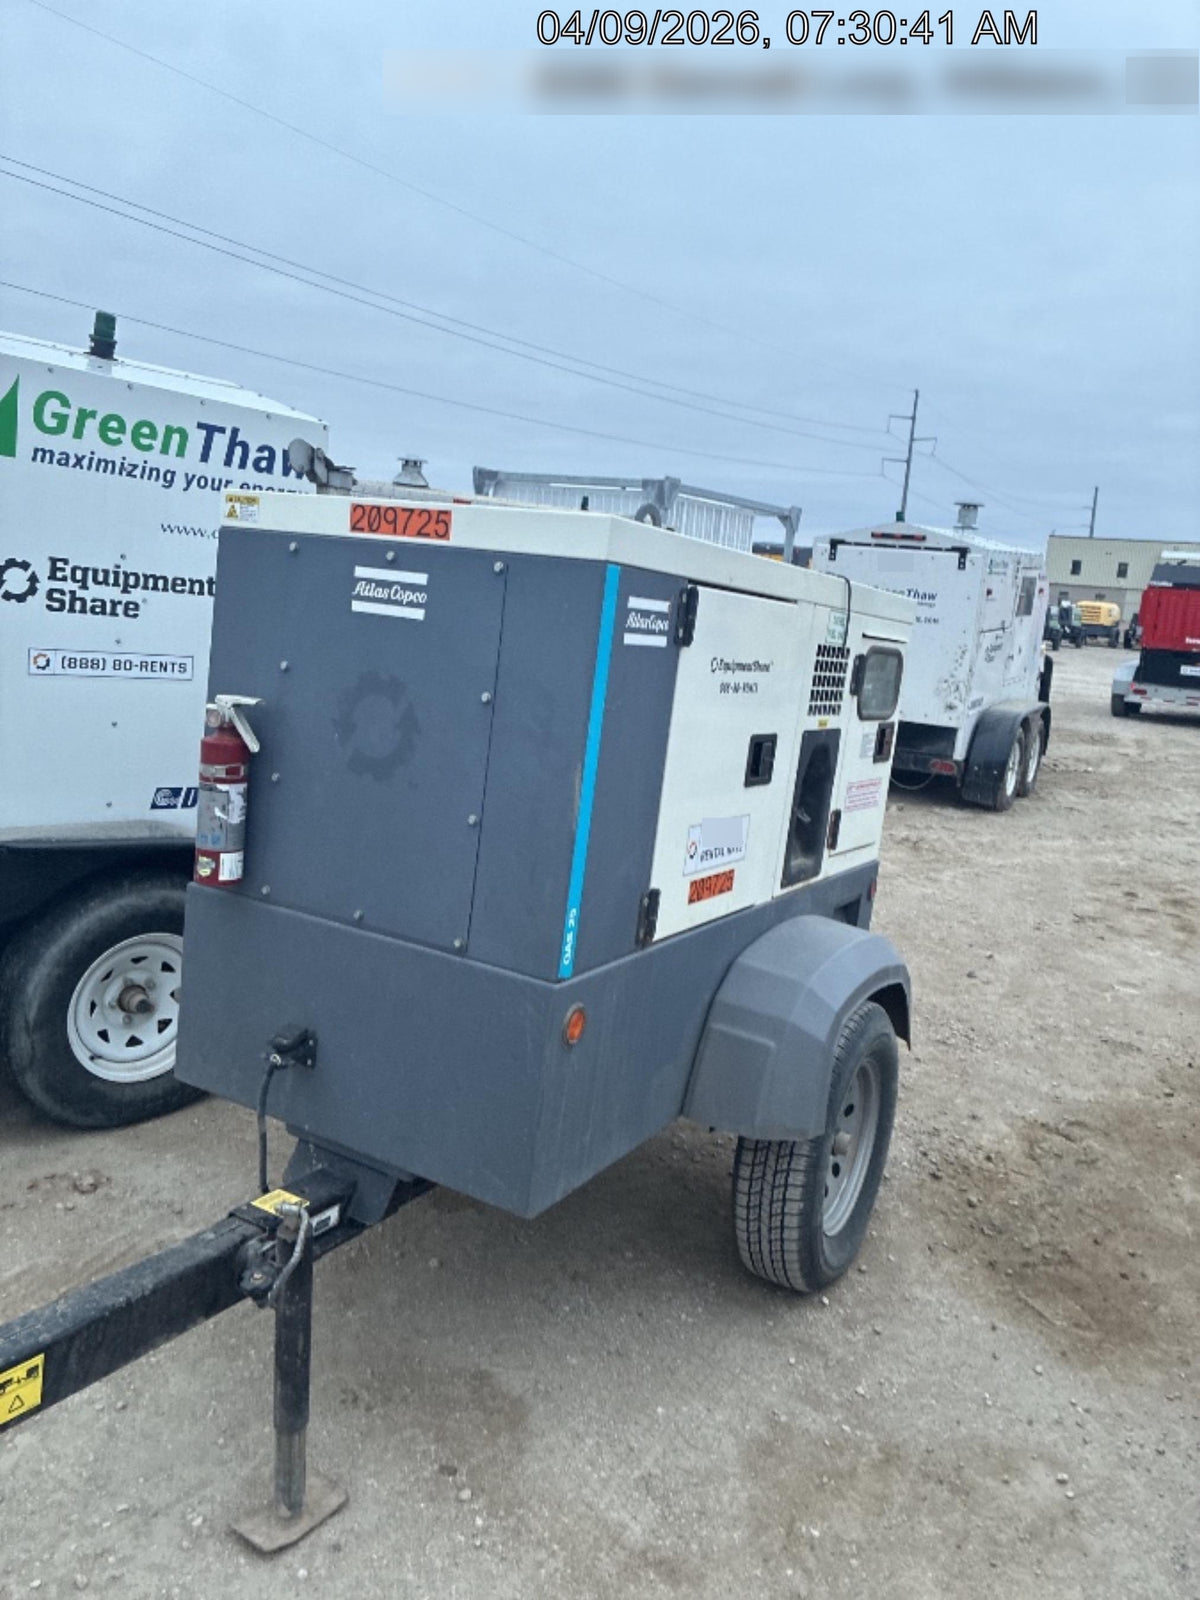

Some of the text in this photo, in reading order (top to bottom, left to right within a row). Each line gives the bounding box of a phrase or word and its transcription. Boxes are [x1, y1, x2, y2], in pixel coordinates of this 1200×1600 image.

[31, 446, 176, 489] maximizing
[182, 473, 233, 492] your
[351, 503, 450, 539] 209725
[48, 556, 216, 597] Equipment
[45, 588, 140, 619] Share
[61, 656, 106, 671] (888)
